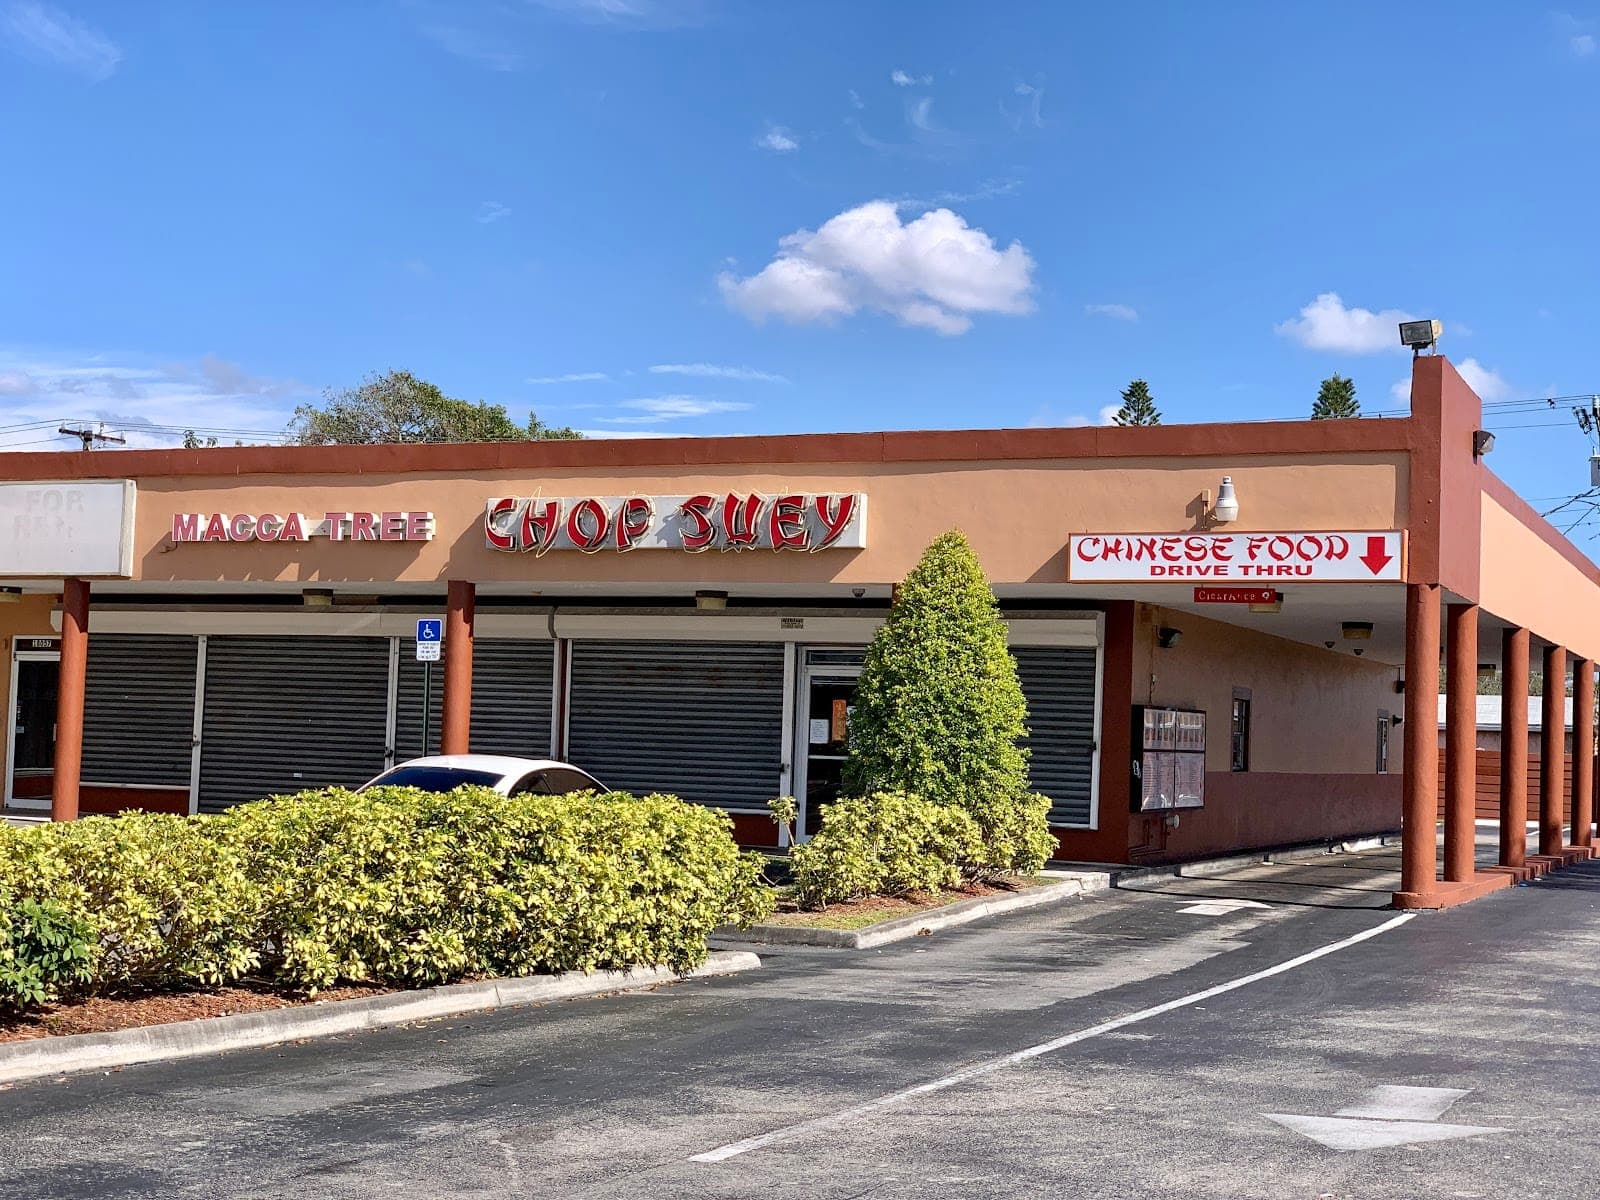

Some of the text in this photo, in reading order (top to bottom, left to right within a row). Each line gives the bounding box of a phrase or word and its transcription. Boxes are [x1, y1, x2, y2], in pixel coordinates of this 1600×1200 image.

[171, 511, 434, 542] MACCA TREE
[485, 491, 858, 554] CHOP SUEY
[1077, 535, 1349, 562] CHINESE FOOD
[1150, 565, 1313, 576] DRIVE THRU
